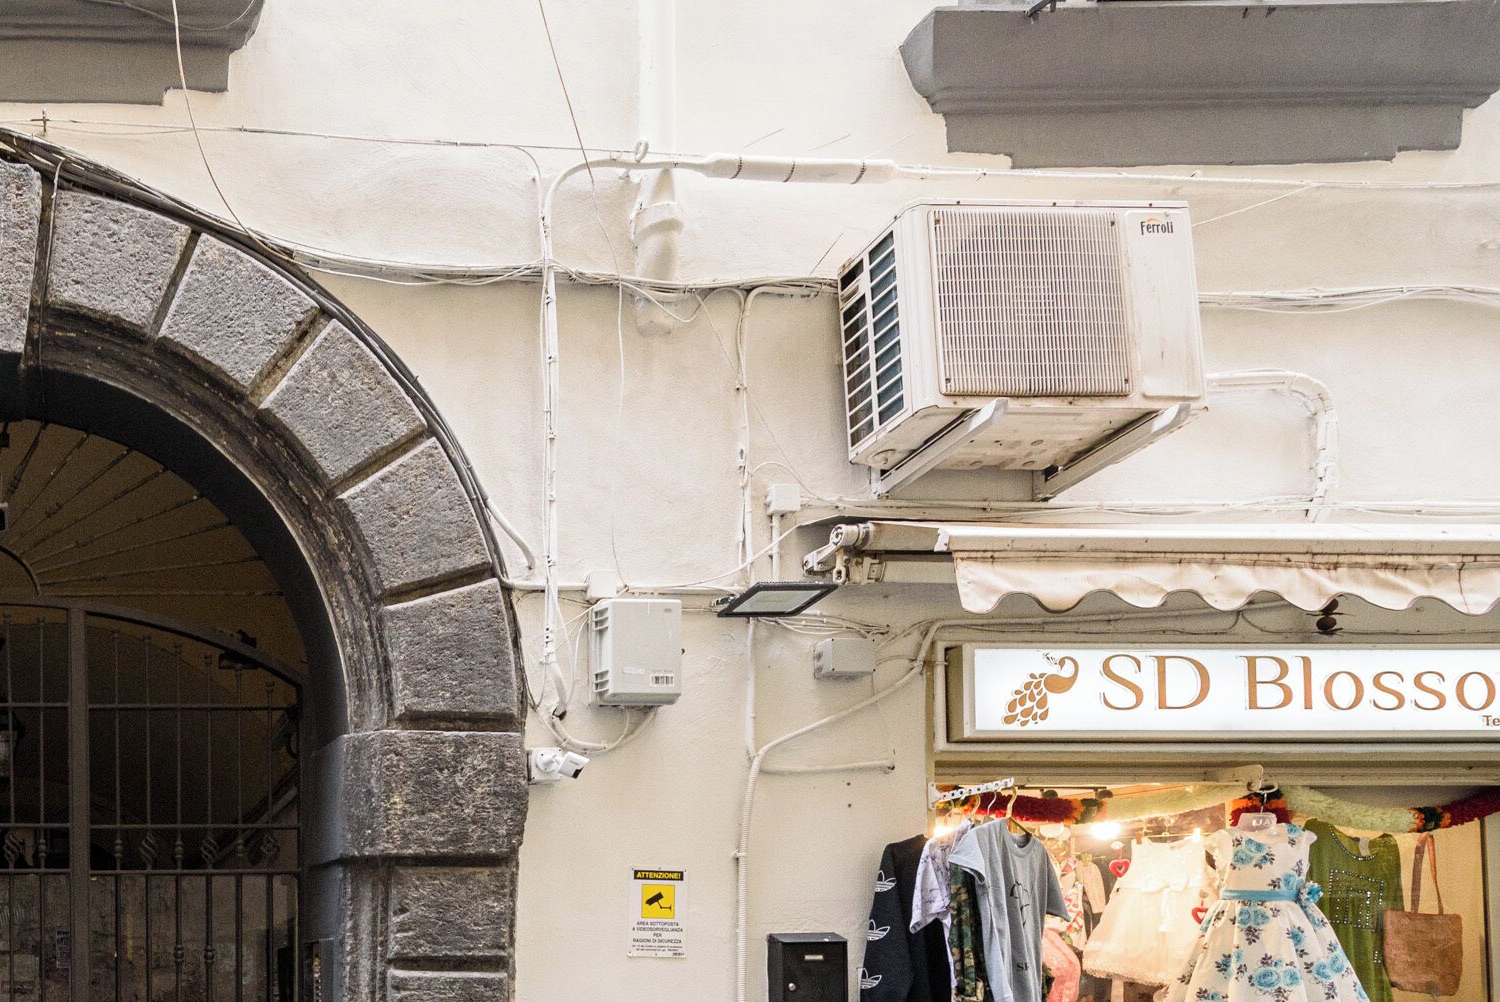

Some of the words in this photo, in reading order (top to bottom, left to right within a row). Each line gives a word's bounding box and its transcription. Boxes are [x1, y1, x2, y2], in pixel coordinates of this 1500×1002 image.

[1140, 221, 1174, 236] Ferroli
[1098, 653, 1212, 712] SD
[1237, 654, 1497, 712] Blosso
[636, 871, 681, 880] ATTENZIONE!
